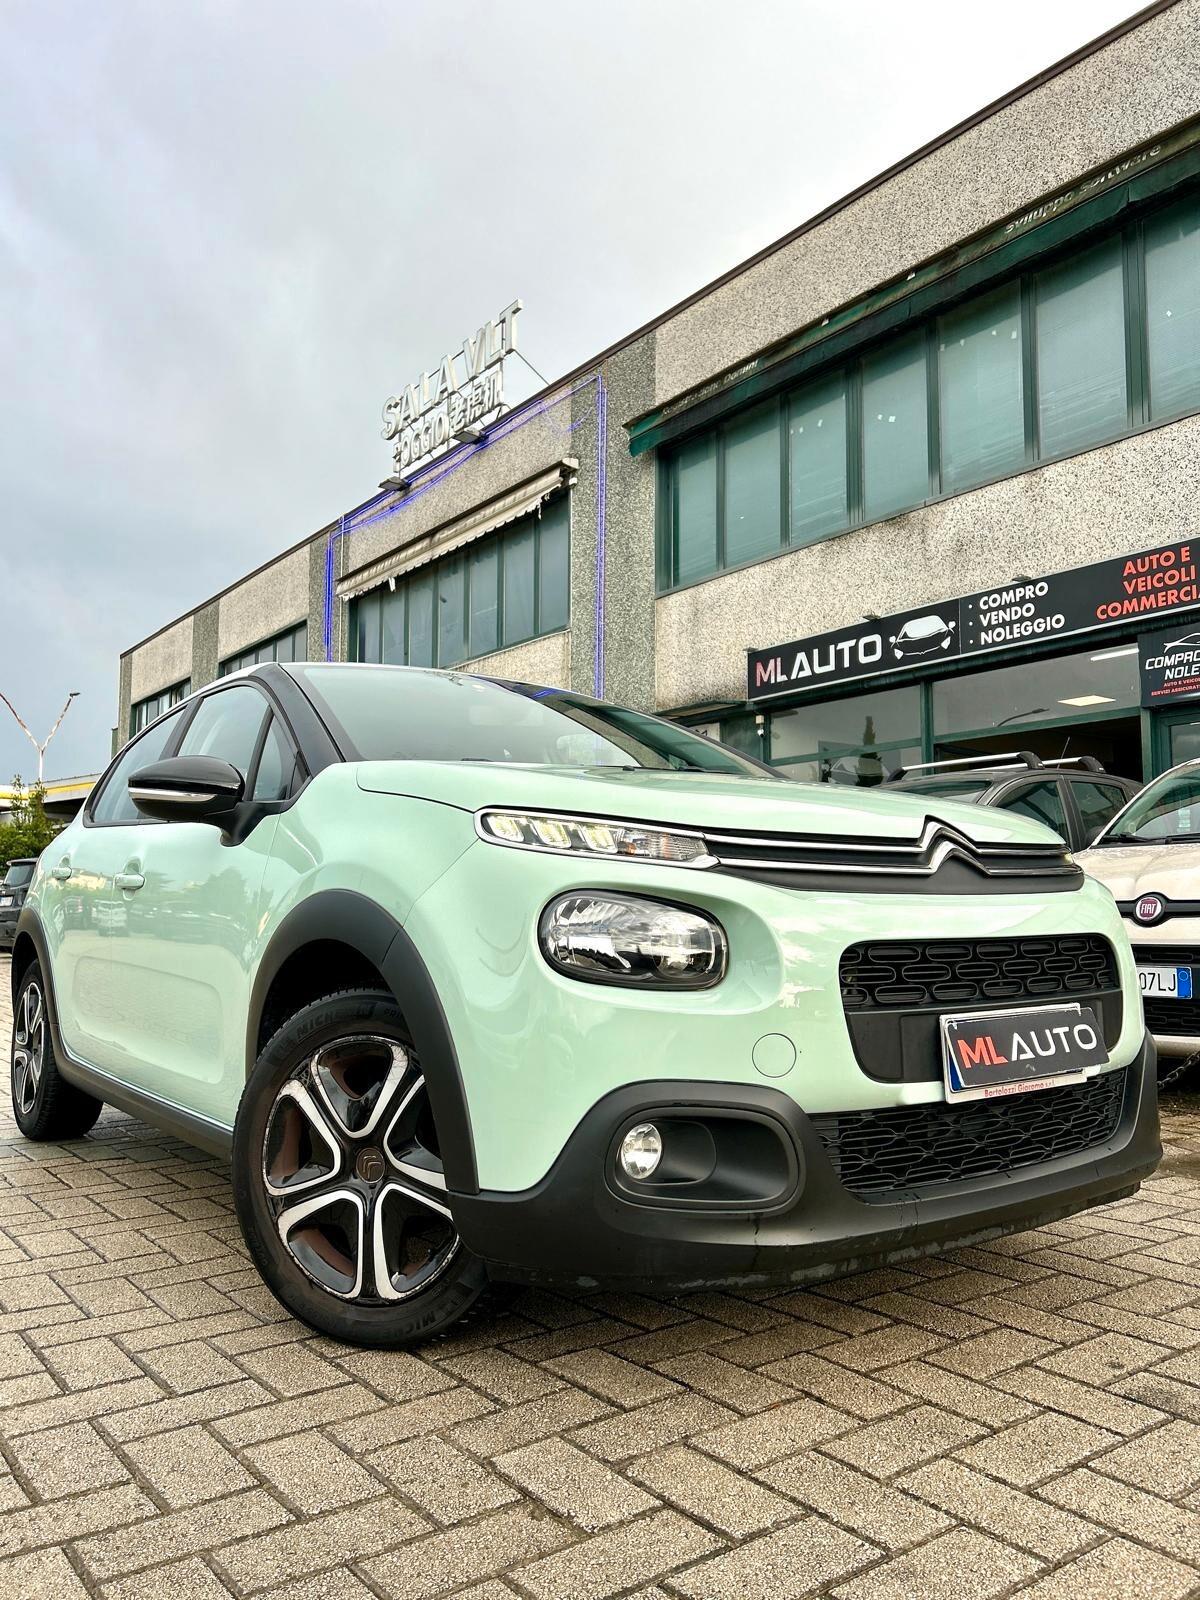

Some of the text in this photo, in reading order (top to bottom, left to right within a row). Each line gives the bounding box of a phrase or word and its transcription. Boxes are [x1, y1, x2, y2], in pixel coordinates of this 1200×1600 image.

[381, 298, 523, 441] SALA VLT
[1123, 546, 1191, 576] AUTO E
[1123, 564, 1196, 595] VEICOLI
[979, 581, 1049, 610] COMPRO
[1096, 584, 1200, 620] COMMERCI
[979, 602, 1035, 627] VENDO
[980, 613, 1066, 646] NOLEGGIO
[1140, 903, 1158, 914] FIAT
[957, 1023, 1098, 1069] ML AUTO
